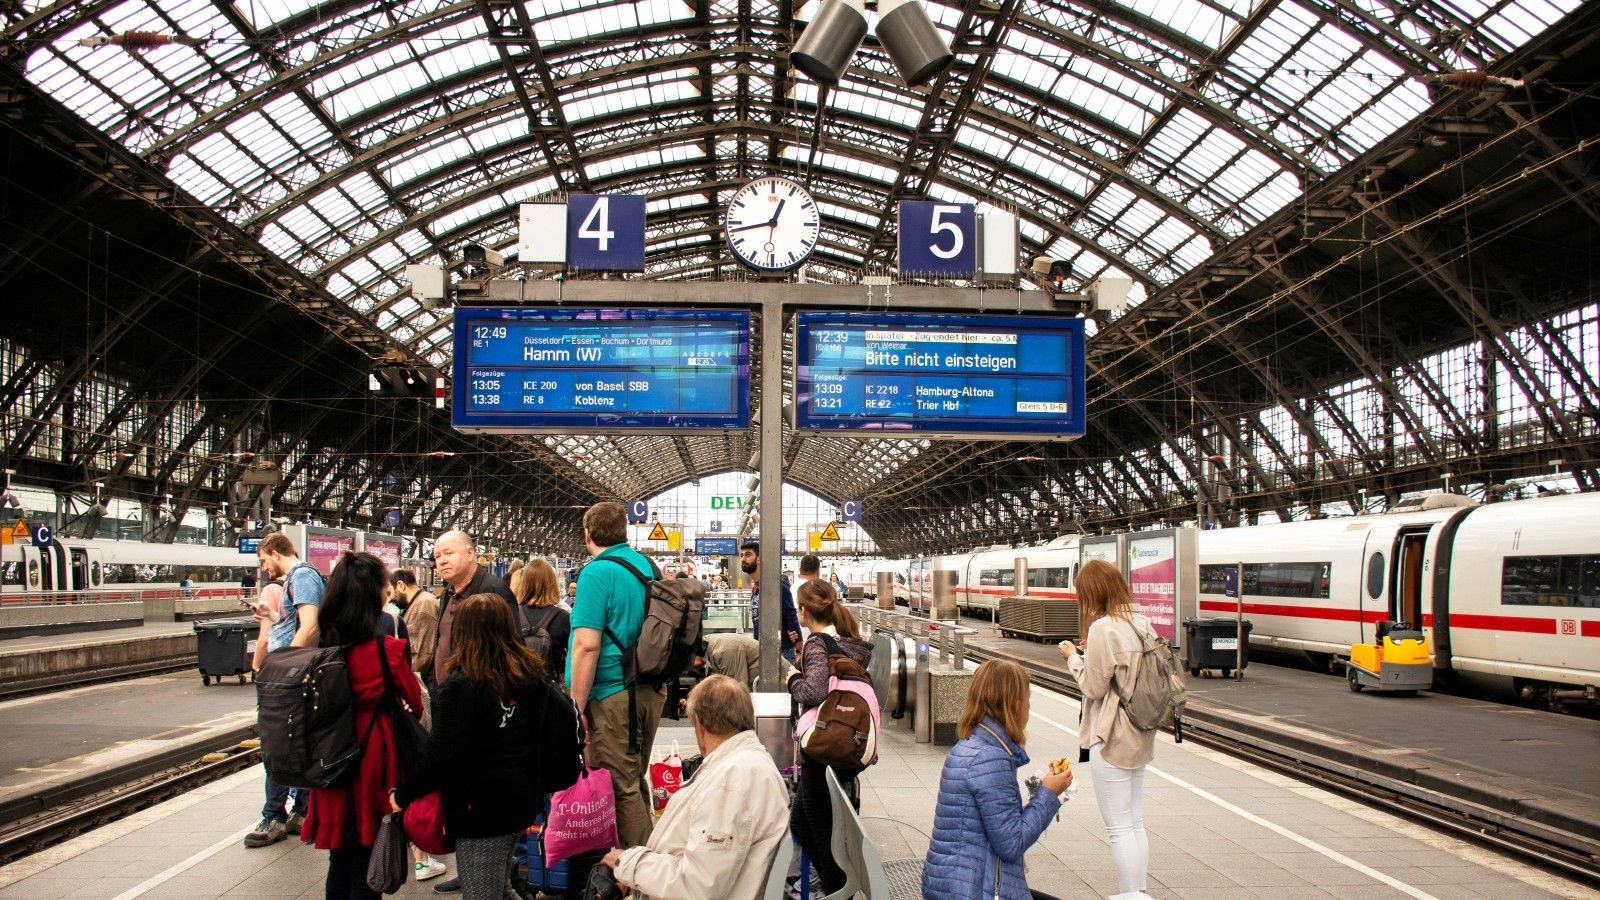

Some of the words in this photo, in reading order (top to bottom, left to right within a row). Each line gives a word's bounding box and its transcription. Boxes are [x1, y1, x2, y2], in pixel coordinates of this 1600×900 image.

[578, 197, 615, 251] 4
[928, 205, 964, 259] 5
[475, 327, 507, 339] 12:49
[816, 331, 848, 343] 12:39
[915, 332, 931, 341] Zug
[933, 333, 959, 341] endet
[961, 333, 978, 341] hier
[524, 336, 565, 345] Düsseldorf
[572, 337, 595, 345] Essen
[601, 337, 630, 345] Bochum
[636, 337, 672, 346] Dortmund
[881, 342, 908, 350] Weimar
[524, 347, 570, 360] Hamm
[576, 347, 602, 361] (W)
[865, 351, 899, 366] Bitte
[904, 352, 940, 367] nicht
[945, 353, 1017, 372] einsteigen
[472, 370, 506, 378] Folgezüge:
[472, 380, 500, 390] 13:05
[524, 381, 538, 390] ICE
[540, 381, 557, 390] 200
[576, 383, 593, 391] von
[596, 381, 625, 391] Basel
[628, 382, 649, 392] SBB
[815, 384, 843, 394] 13:09
[865, 386, 874, 394] IC
[876, 386, 898, 394] 2218
[916, 386, 994, 398] Hamburg-Altona
[472, 394, 500, 405] 13:38
[524, 395, 535, 404] RE
[538, 395, 544, 404] 8
[575, 395, 615, 406] Koblenz
[815, 398, 842, 408] 13:21
[865, 399, 876, 408] RE
[880, 399, 891, 408] 22
[916, 400, 939, 410] Trier
[943, 400, 960, 411] Hbf
[1019, 402, 1041, 410] Gleis
[1042, 403, 1048, 411] 5
[634, 501, 645, 516] C
[844, 501, 856, 516] C
[256, 520, 263, 528] 2
[38, 527, 49, 542] C
[1322, 564, 1328, 578] 2
[1563, 622, 1574, 632] DB
[565, 816, 602, 828] Anderes
[580, 830, 588, 839] in
[590, 826, 602, 837] die
